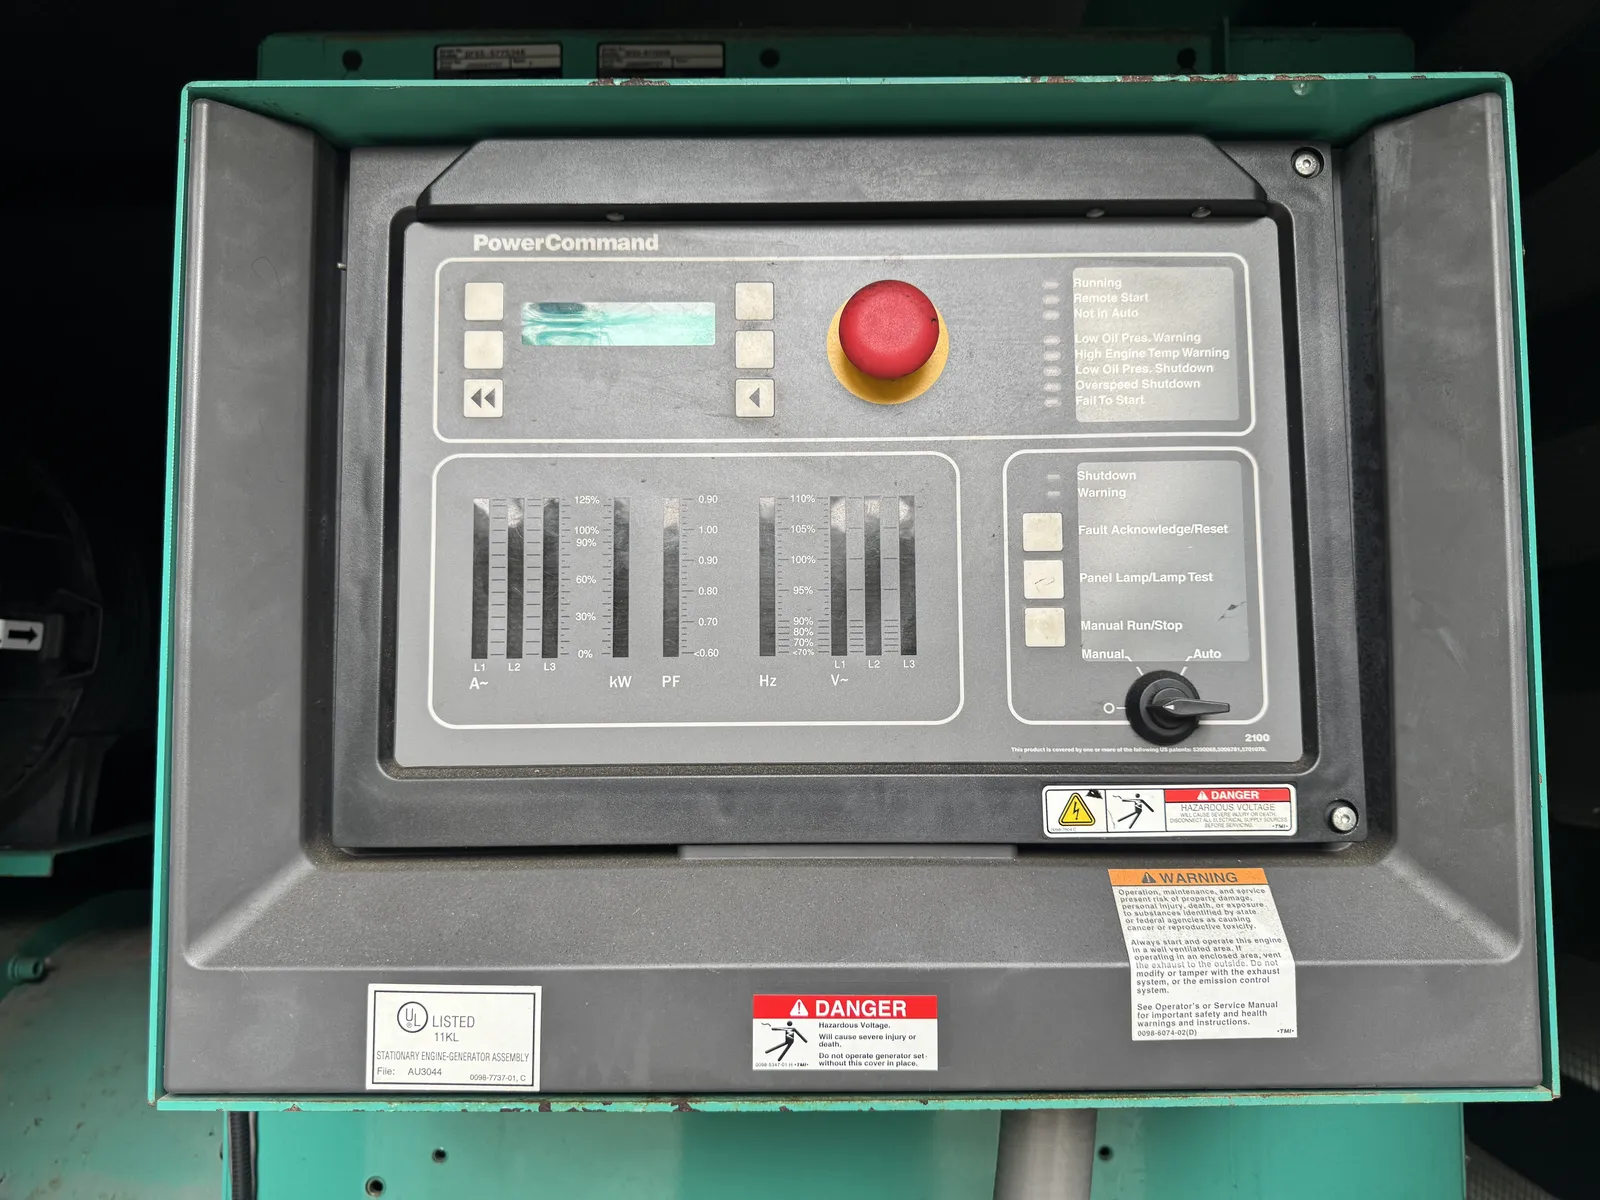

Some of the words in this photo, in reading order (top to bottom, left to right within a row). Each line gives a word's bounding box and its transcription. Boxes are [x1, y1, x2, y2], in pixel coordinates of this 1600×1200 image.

[474, 234, 658, 251] PowerCommand
[1074, 278, 1121, 290] Running
[1074, 293, 1118, 303] Remote
[1121, 293, 1148, 302] Start
[1074, 308, 1095, 319] Not
[1098, 308, 1108, 319] in
[1112, 308, 1139, 319] Auto
[1075, 334, 1099, 346] Low
[1102, 333, 1118, 345] Oil
[1122, 333, 1151, 343] Pres.
[1153, 333, 1200, 344] Warning
[1075, 349, 1102, 361] High
[1106, 348, 1146, 361] Engine
[1148, 348, 1180, 360] Temp
[1182, 348, 1229, 359] Warning
[1076, 365, 1100, 376] Low
[1103, 364, 1119, 375] Oil
[1122, 364, 1153, 376] Pres.
[1155, 364, 1213, 373] Shutdown
[1076, 380, 1138, 392] Overspeed
[1142, 380, 1200, 389] Shutdown
[1076, 396, 1097, 407] Fail
[1098, 396, 1113, 405] To
[1116, 395, 1146, 406] Start
[1078, 471, 1136, 480] Shutdown
[791, 494, 815, 503] 110%
[1078, 488, 1128, 500] Warning
[575, 496, 600, 504] 125%
[698, 495, 718, 504] 0.90
[574, 526, 600, 534] 100%
[699, 526, 718, 534] 1.00
[791, 525, 815, 533] 105%
[1079, 525, 1108, 535] Fault
[1111, 524, 1228, 536] Acknowledge/Reset
[576, 538, 597, 547] 90%
[699, 556, 718, 564] 0.90
[791, 556, 816, 564] 100%
[576, 575, 596, 584] 60%
[1080, 573, 1112, 583] Panel
[1116, 572, 1186, 585] Lamp/Lamp
[1188, 572, 1213, 582] Test
[699, 587, 718, 596] 0.80
[793, 586, 813, 594] 95%
[576, 612, 596, 621] 30%
[793, 617, 813, 625] 90%
[699, 618, 718, 626] 0.70
[1081, 621, 1123, 630] Manual
[1127, 620, 1183, 632] Run/Stop
[793, 627, 814, 636] 80%
[794, 638, 814, 646] 70%
[578, 650, 593, 658] 0%
[694, 648, 719, 657] <0.60
[1082, 649, 1125, 659] Manual
[1193, 649, 1221, 658] Auto
[474, 663, 485, 672] L1
[509, 663, 520, 671] L2
[544, 663, 556, 671] L3
[835, 660, 845, 668] L1
[868, 660, 880, 668] L2
[904, 660, 915, 668] L3
[610, 676, 632, 688] kW
[662, 676, 680, 687] PF
[760, 675, 776, 687] Hz
[1245, 734, 1270, 742] 2100
[1212, 791, 1259, 800] DANGER
[1181, 804, 1234, 812] HAZARDOUS
[1159, 872, 1239, 885] WARNING
[1163, 889, 1218, 897] maintenance,
[1220, 888, 1234, 896] and
[1153, 896, 1169, 904] risk
[1181, 896, 1216, 904] property
[1122, 904, 1158, 912] personal
[1159, 903, 1186, 911] injury,
[1188, 903, 1214, 911] death,
[1226, 903, 1264, 911] exposure
[1236, 909, 1256, 917] state
[1132, 940, 1160, 948] Always
[1184, 939, 1200, 947] and
[1202, 938, 1233, 947] operate
[1236, 938, 1252, 946] this
[1136, 970, 1164, 978] modify
[1211, 969, 1228, 978] with
[1247, 968, 1280, 977] exhaust
[1137, 978, 1169, 987] system,
[1240, 976, 1270, 984] control
[1137, 988, 1169, 996] system.
[816, 1000, 906, 1017] DANGER
[1137, 1004, 1152, 1013] See
[1155, 1003, 1200, 1012] Operator's
[1202, 1004, 1211, 1012] or
[1214, 1002, 1245, 1011] Service
[1248, 1001, 1278, 1011] Manual
[1152, 1012, 1192, 1020] important
[1195, 1011, 1220, 1020] safety
[1223, 1010, 1238, 1019] and
[433, 1015, 475, 1028] LISTED
[861, 1022, 890, 1030] Voltage.
[1138, 1019, 1176, 1028] warnings
[435, 1032, 459, 1042] 11KL
[1138, 1029, 1197, 1037] 0098-6074-02(D)
[819, 1034, 832, 1042] Will
[377, 1051, 420, 1060] STATIONARY
[422, 1052, 490, 1062] ENGINE-GENERATOR
[492, 1053, 529, 1062] ASSEMBLY
[819, 1053, 829, 1061] Do
[844, 1053, 873, 1061] operate
[875, 1054, 911, 1062] generator
[377, 1067, 395, 1075] File:
[408, 1068, 442, 1076] AU3044
